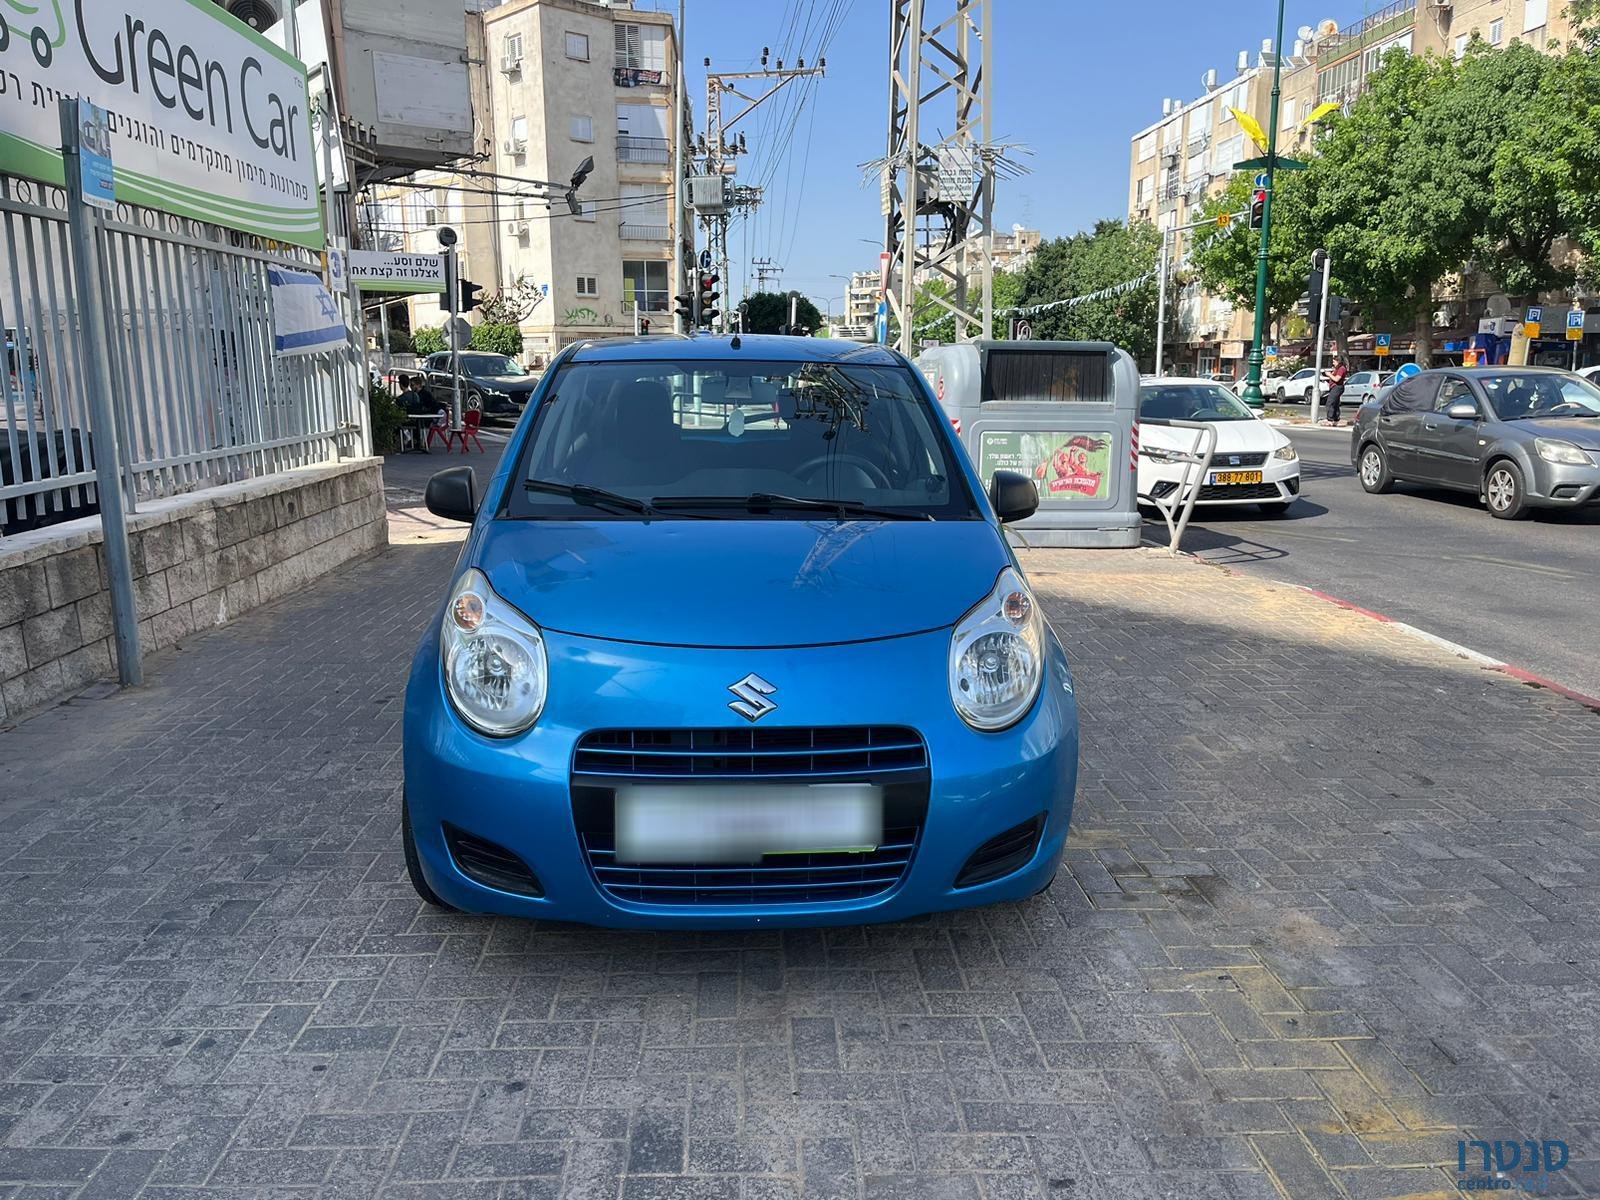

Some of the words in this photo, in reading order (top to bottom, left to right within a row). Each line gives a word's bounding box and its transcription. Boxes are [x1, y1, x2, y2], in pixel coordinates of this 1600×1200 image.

[75, 0, 233, 134] Green
[240, 56, 298, 162] Car
[106, 109, 165, 150] והוגנים
[171, 133, 233, 174] מתקדמים
[236, 158, 267, 185] מימון
[270, 170, 309, 201] פתרונות
[1219, 215, 1228, 225] 13
[383, 257, 412, 266] וסע...
[416, 257, 439, 267] שלם
[370, 266, 393, 278] קצת
[396, 268, 408, 277] זה
[411, 267, 439, 278] אצלנו
